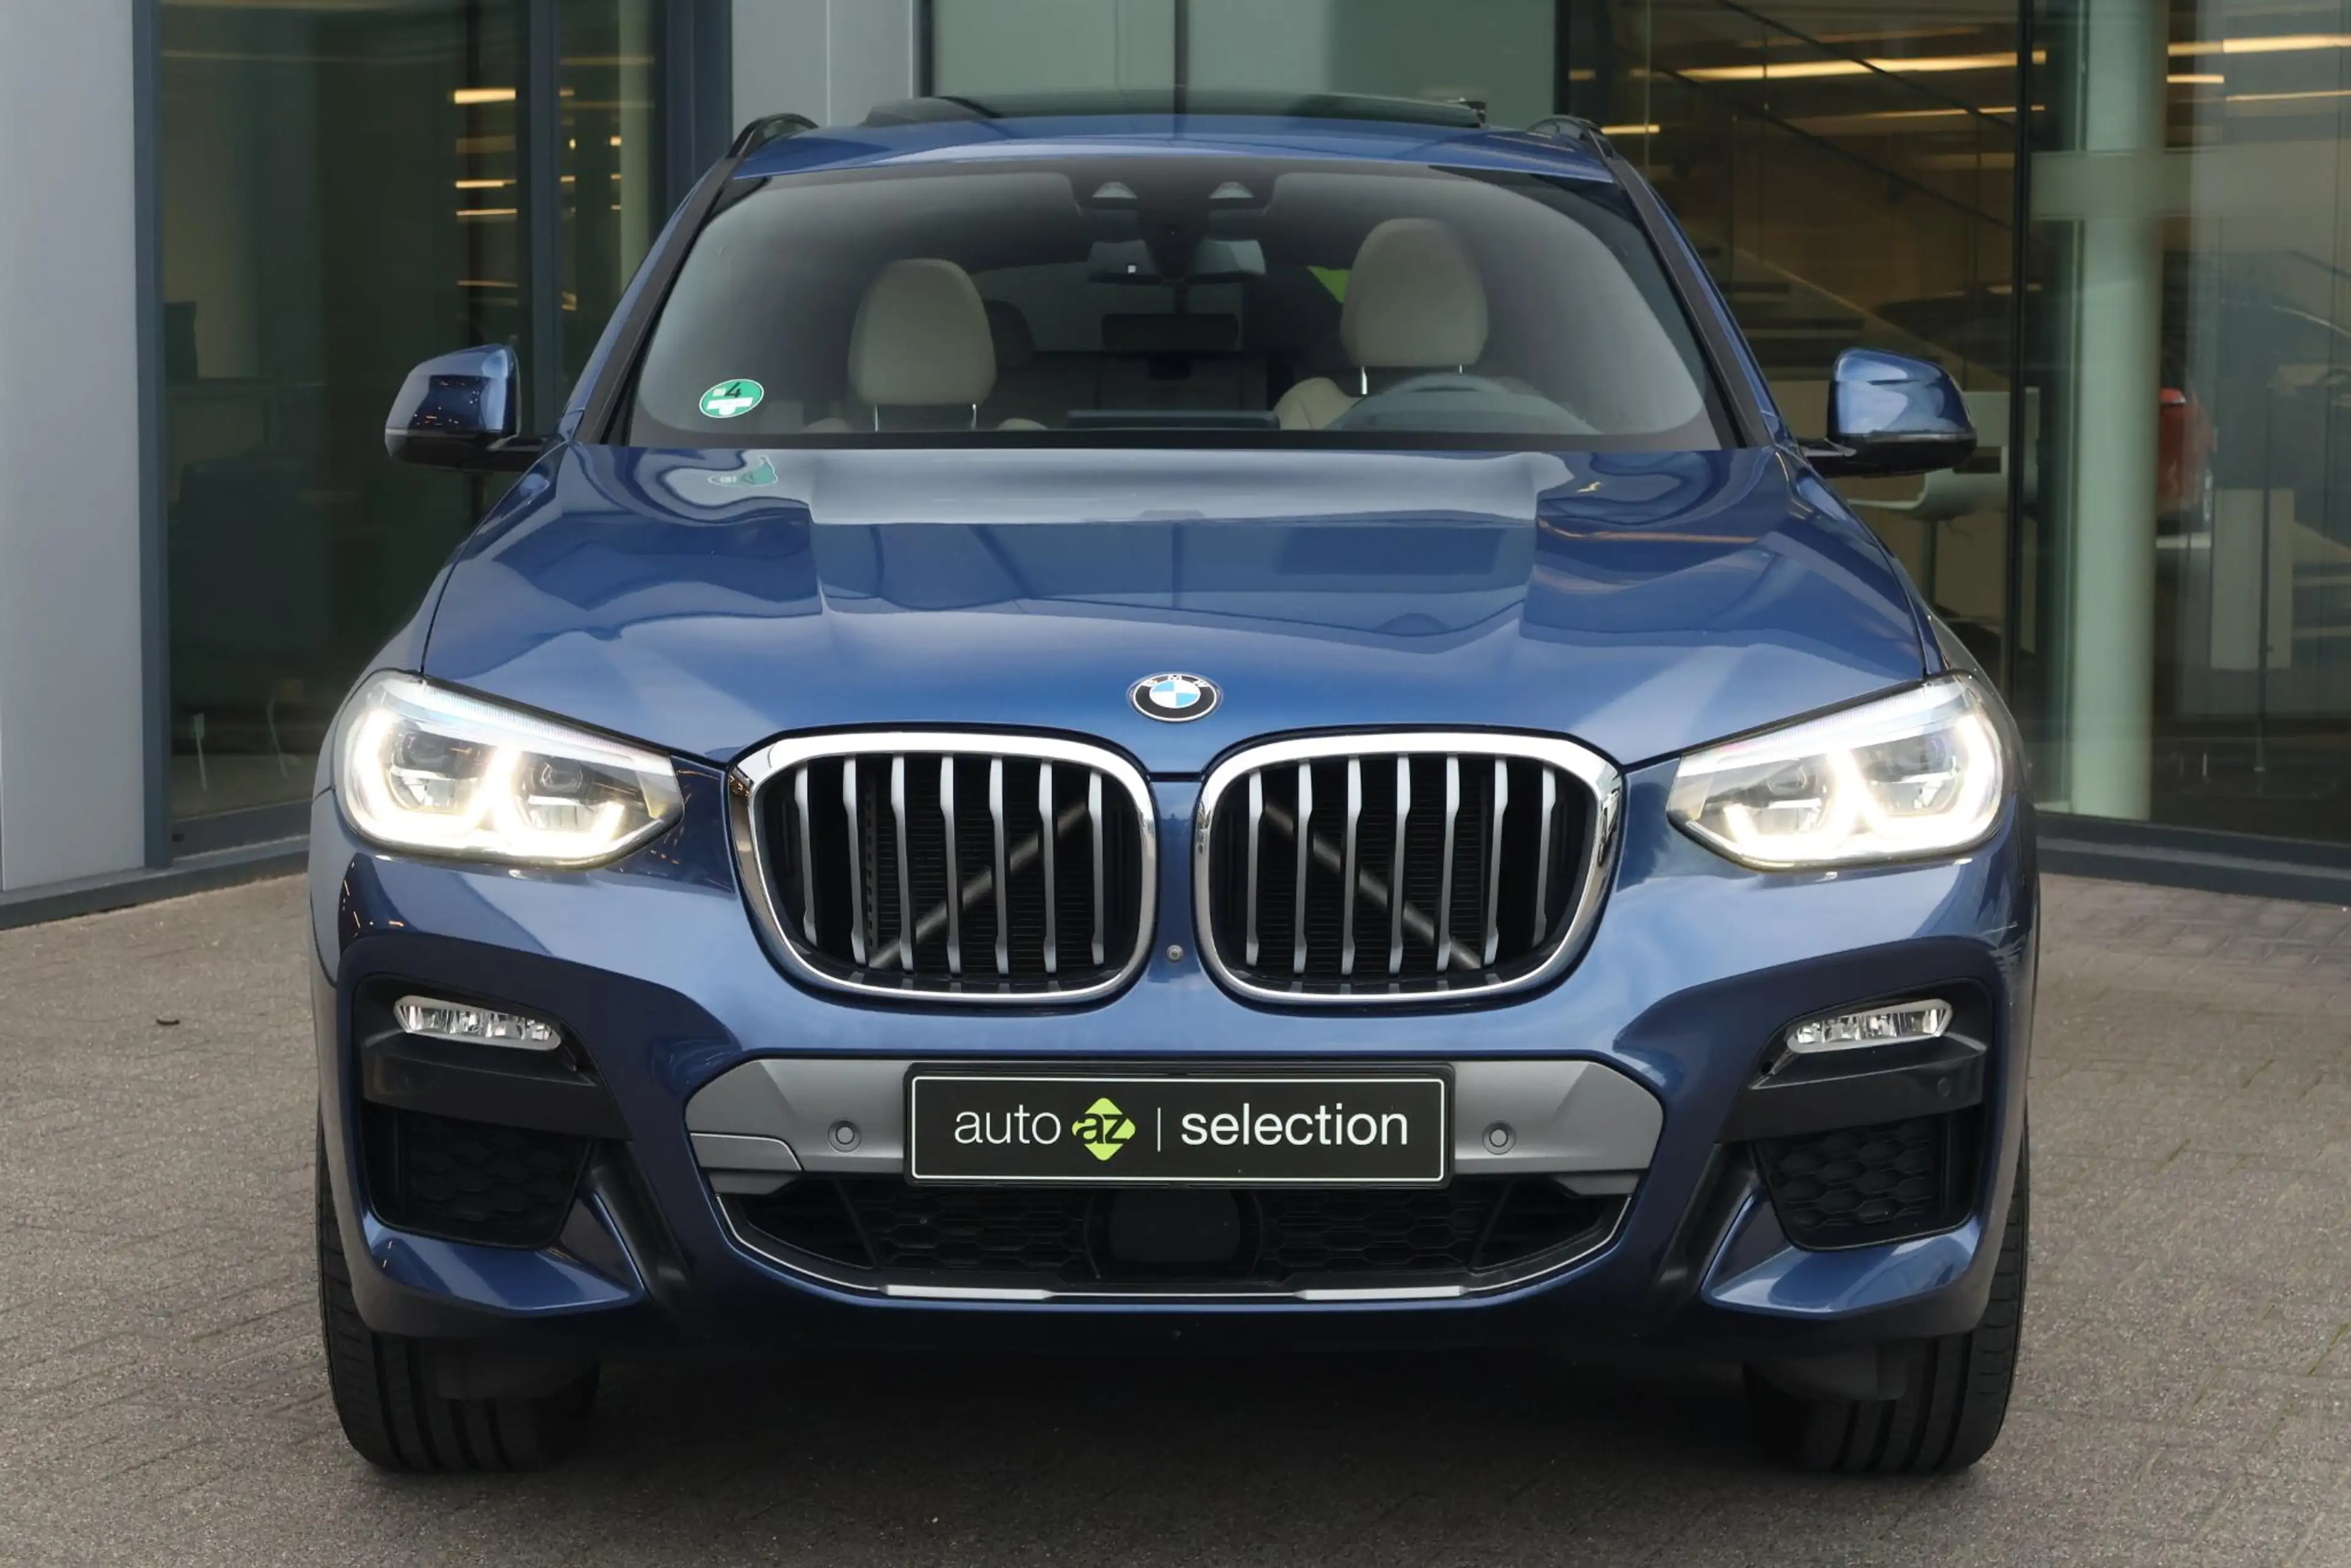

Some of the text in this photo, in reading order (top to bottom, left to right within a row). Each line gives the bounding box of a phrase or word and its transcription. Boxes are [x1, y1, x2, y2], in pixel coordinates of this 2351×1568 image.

[724, 382, 741, 398] 4
[954, 1103, 1408, 1146] auto az selection
